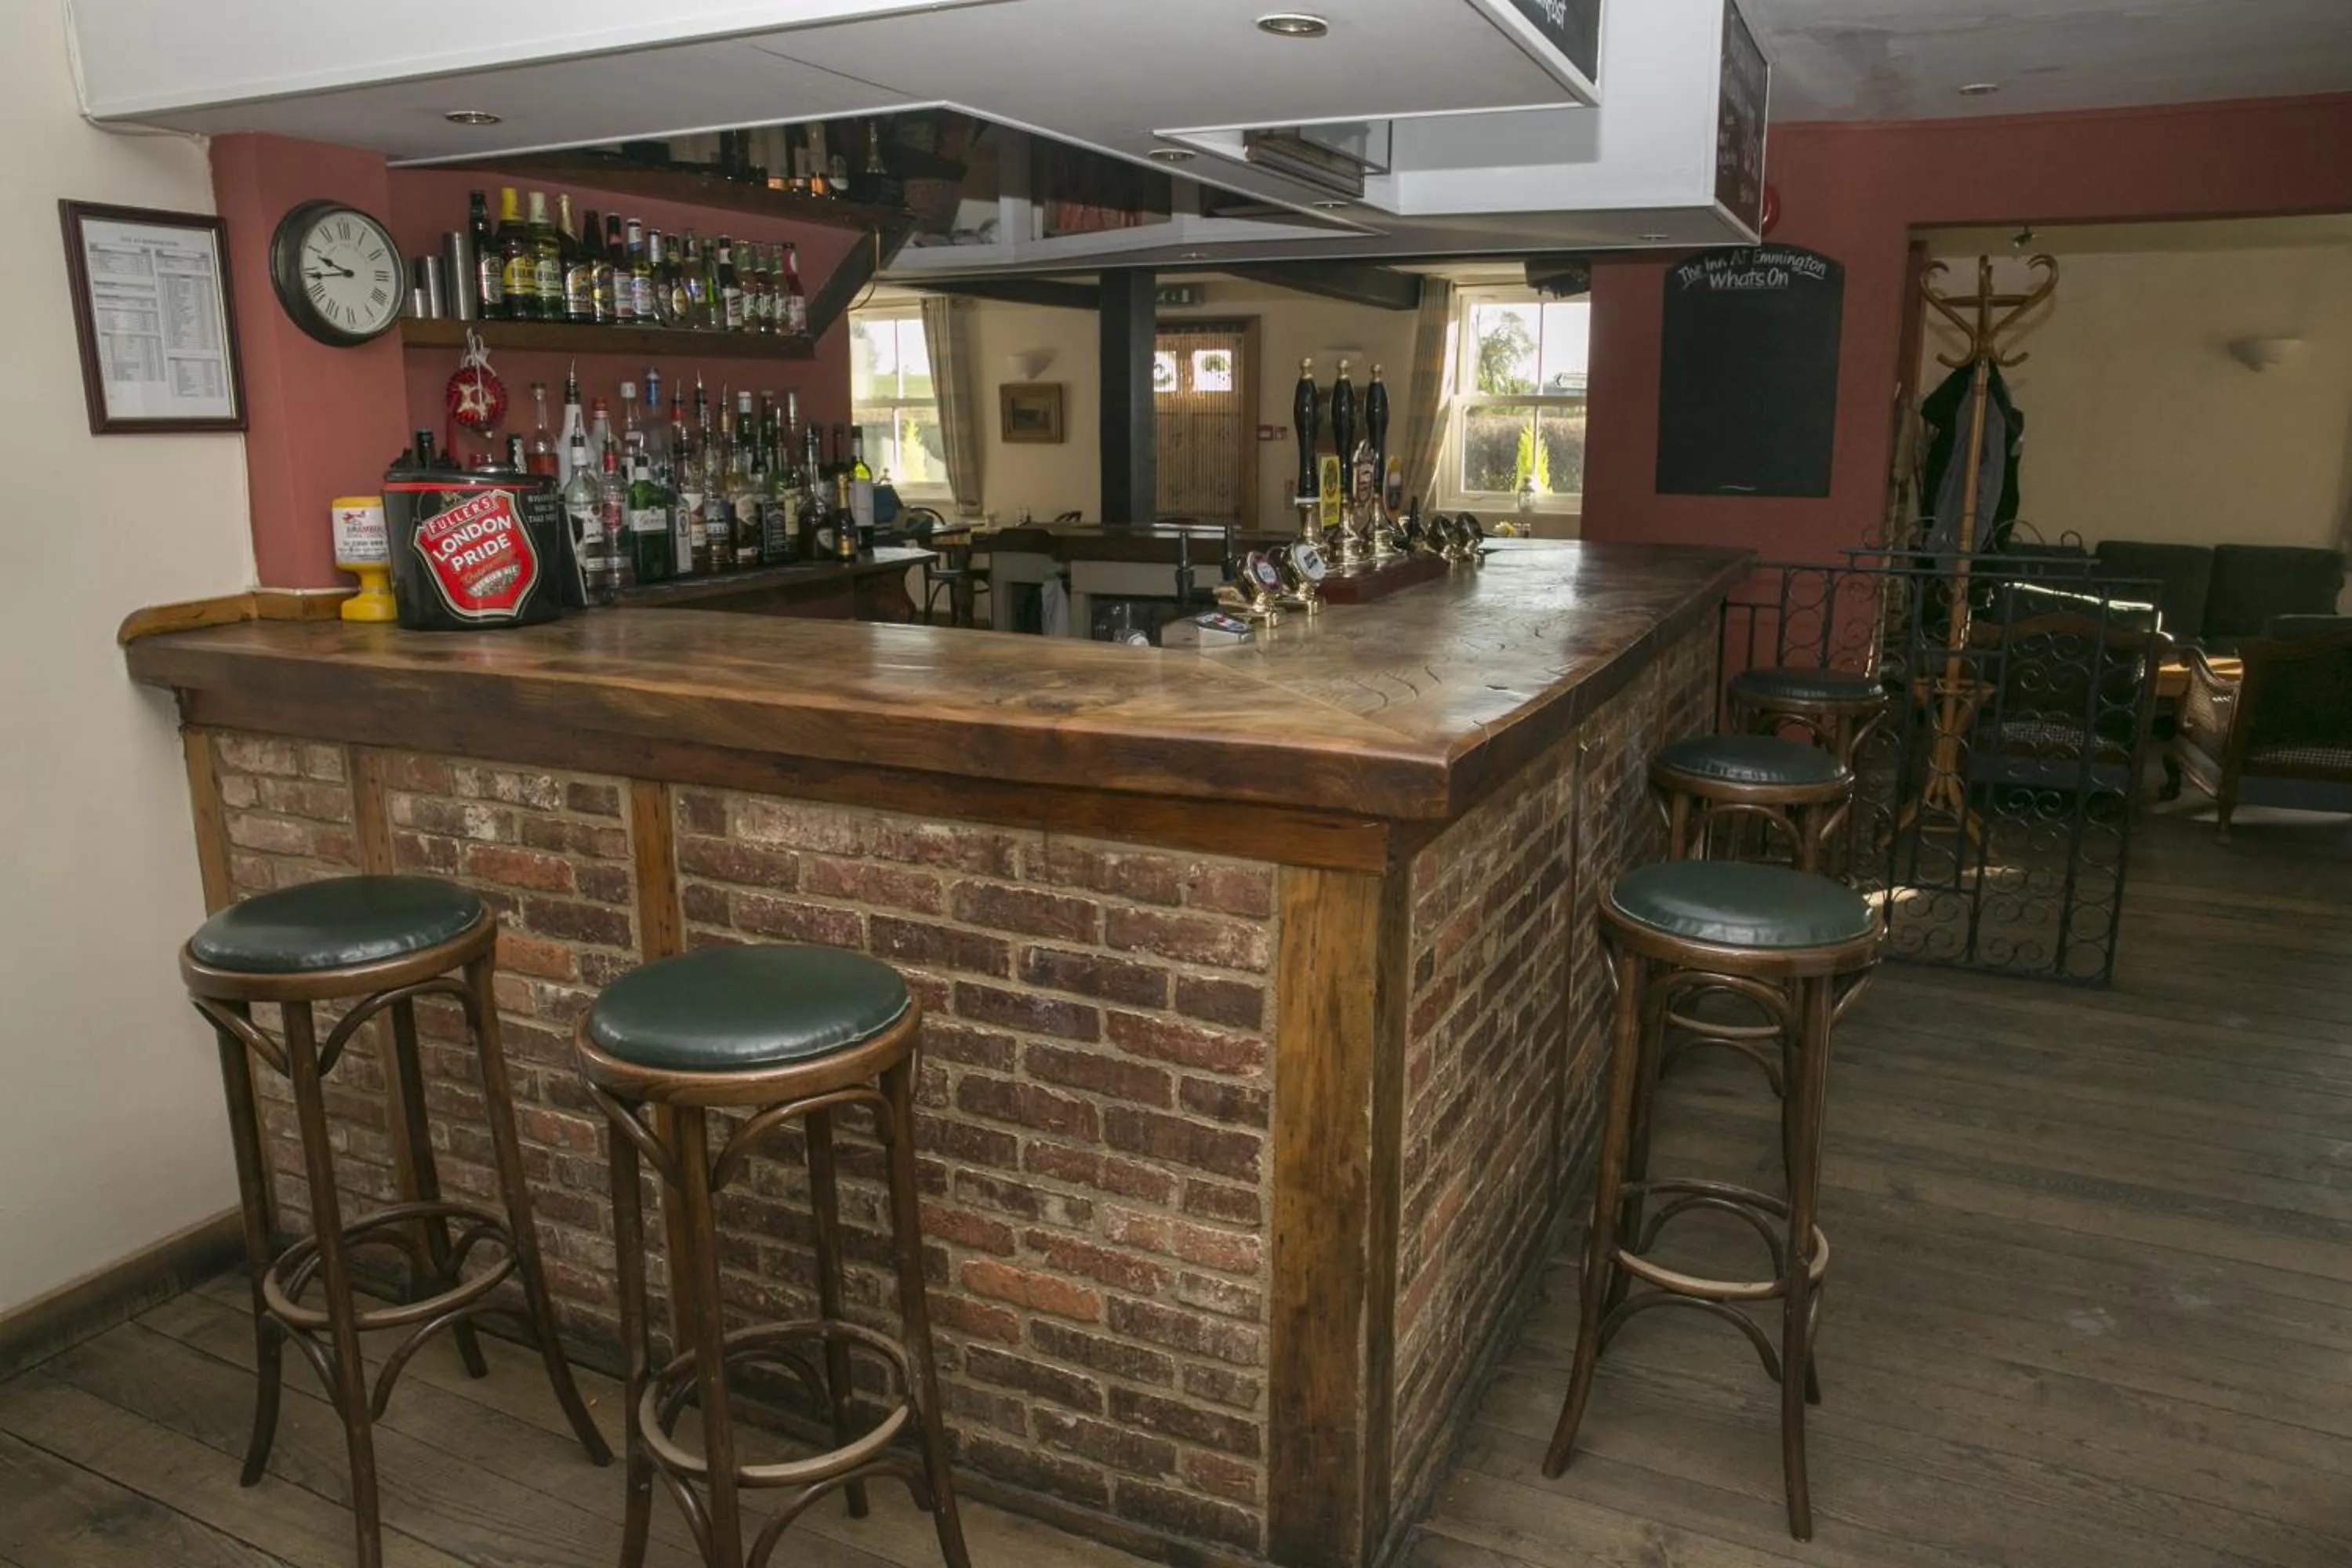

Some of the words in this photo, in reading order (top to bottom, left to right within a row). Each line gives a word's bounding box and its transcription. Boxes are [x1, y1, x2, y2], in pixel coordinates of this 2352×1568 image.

[1678, 263, 1703, 282] The
[1705, 256, 1728, 271] Inn
[1752, 248, 1827, 276] Emmington
[1767, 267, 1788, 286] On
[432, 514, 512, 562] LONDON
[451, 533, 511, 572] PRIDE
